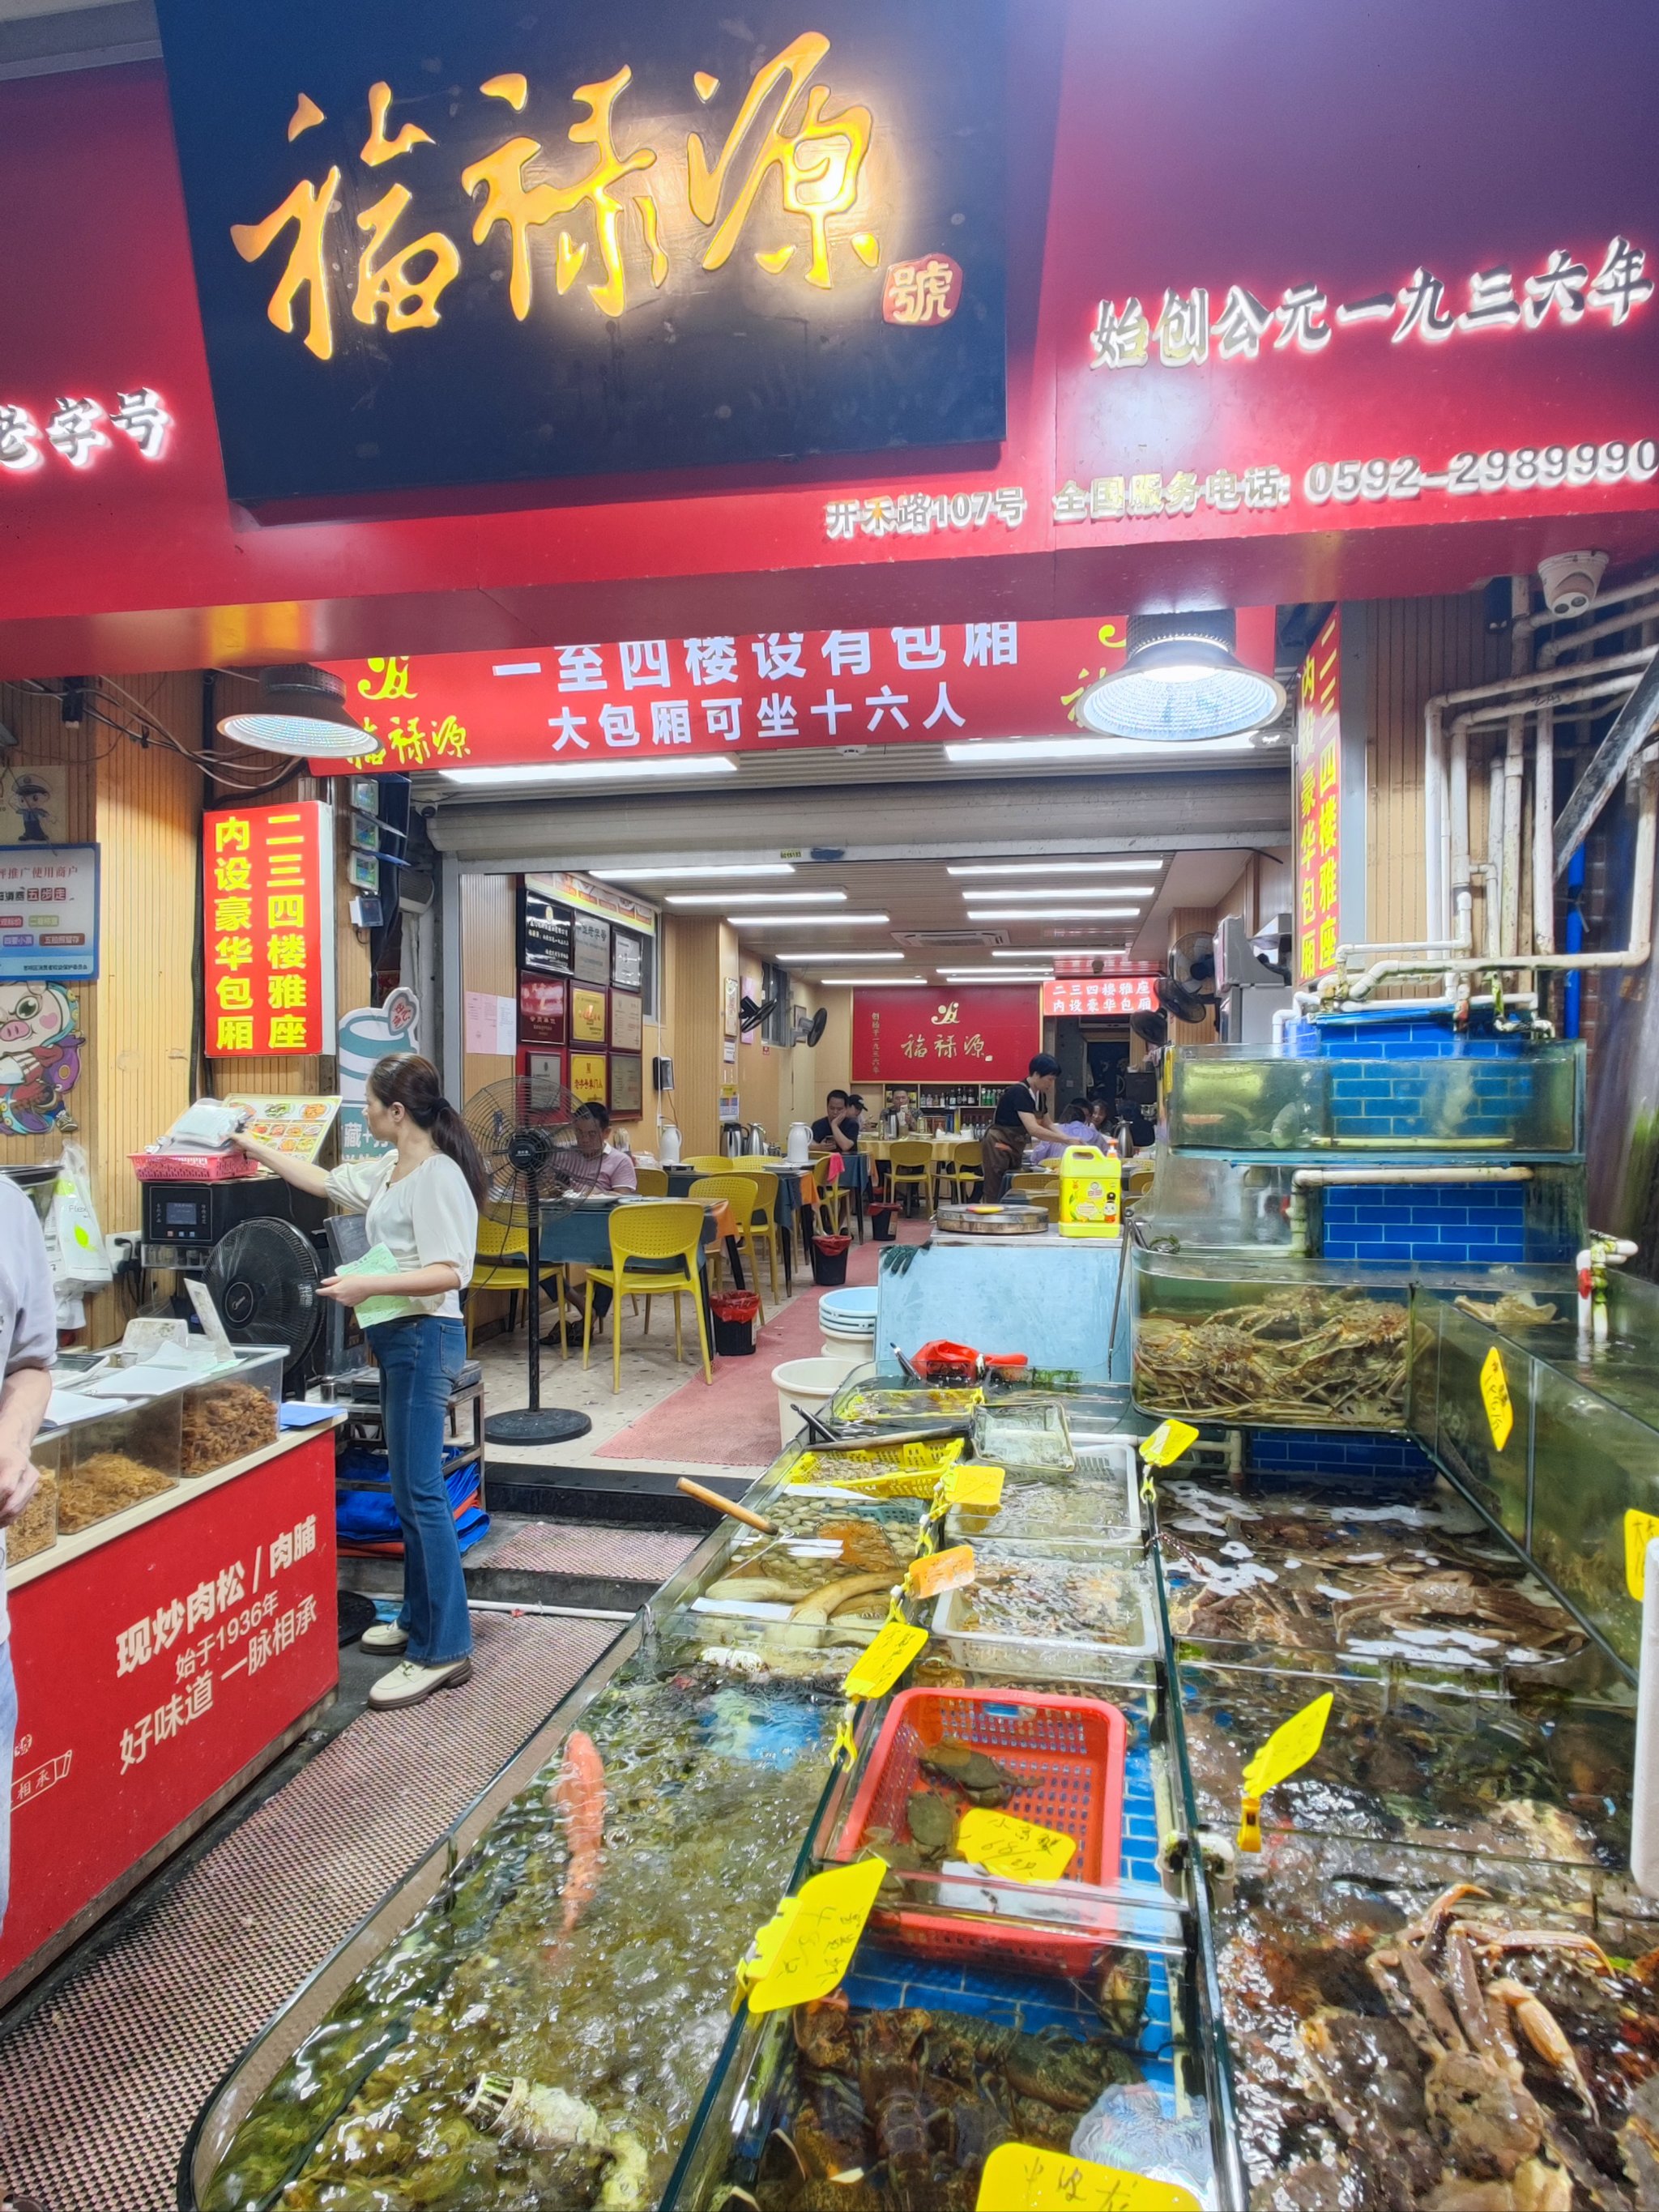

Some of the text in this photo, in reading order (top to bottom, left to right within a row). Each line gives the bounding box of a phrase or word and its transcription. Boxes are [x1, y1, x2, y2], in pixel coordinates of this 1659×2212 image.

[231, 31, 881, 360] 福禄源
[1090, 236, 1654, 370] 始创公元一九三六年
[825, 487, 1027, 540] 开禾路107号
[491, 620, 1019, 693] 一至四楼设有包厢
[547, 681, 967, 752] 大包厢可坐十六人
[214, 817, 254, 1051] 内设豪华包厢
[266, 814, 307, 1049] 二三四楼雅座
[900, 1034, 986, 1059] 福禄源
[175, 1589, 279, 1684] 始于1936年
